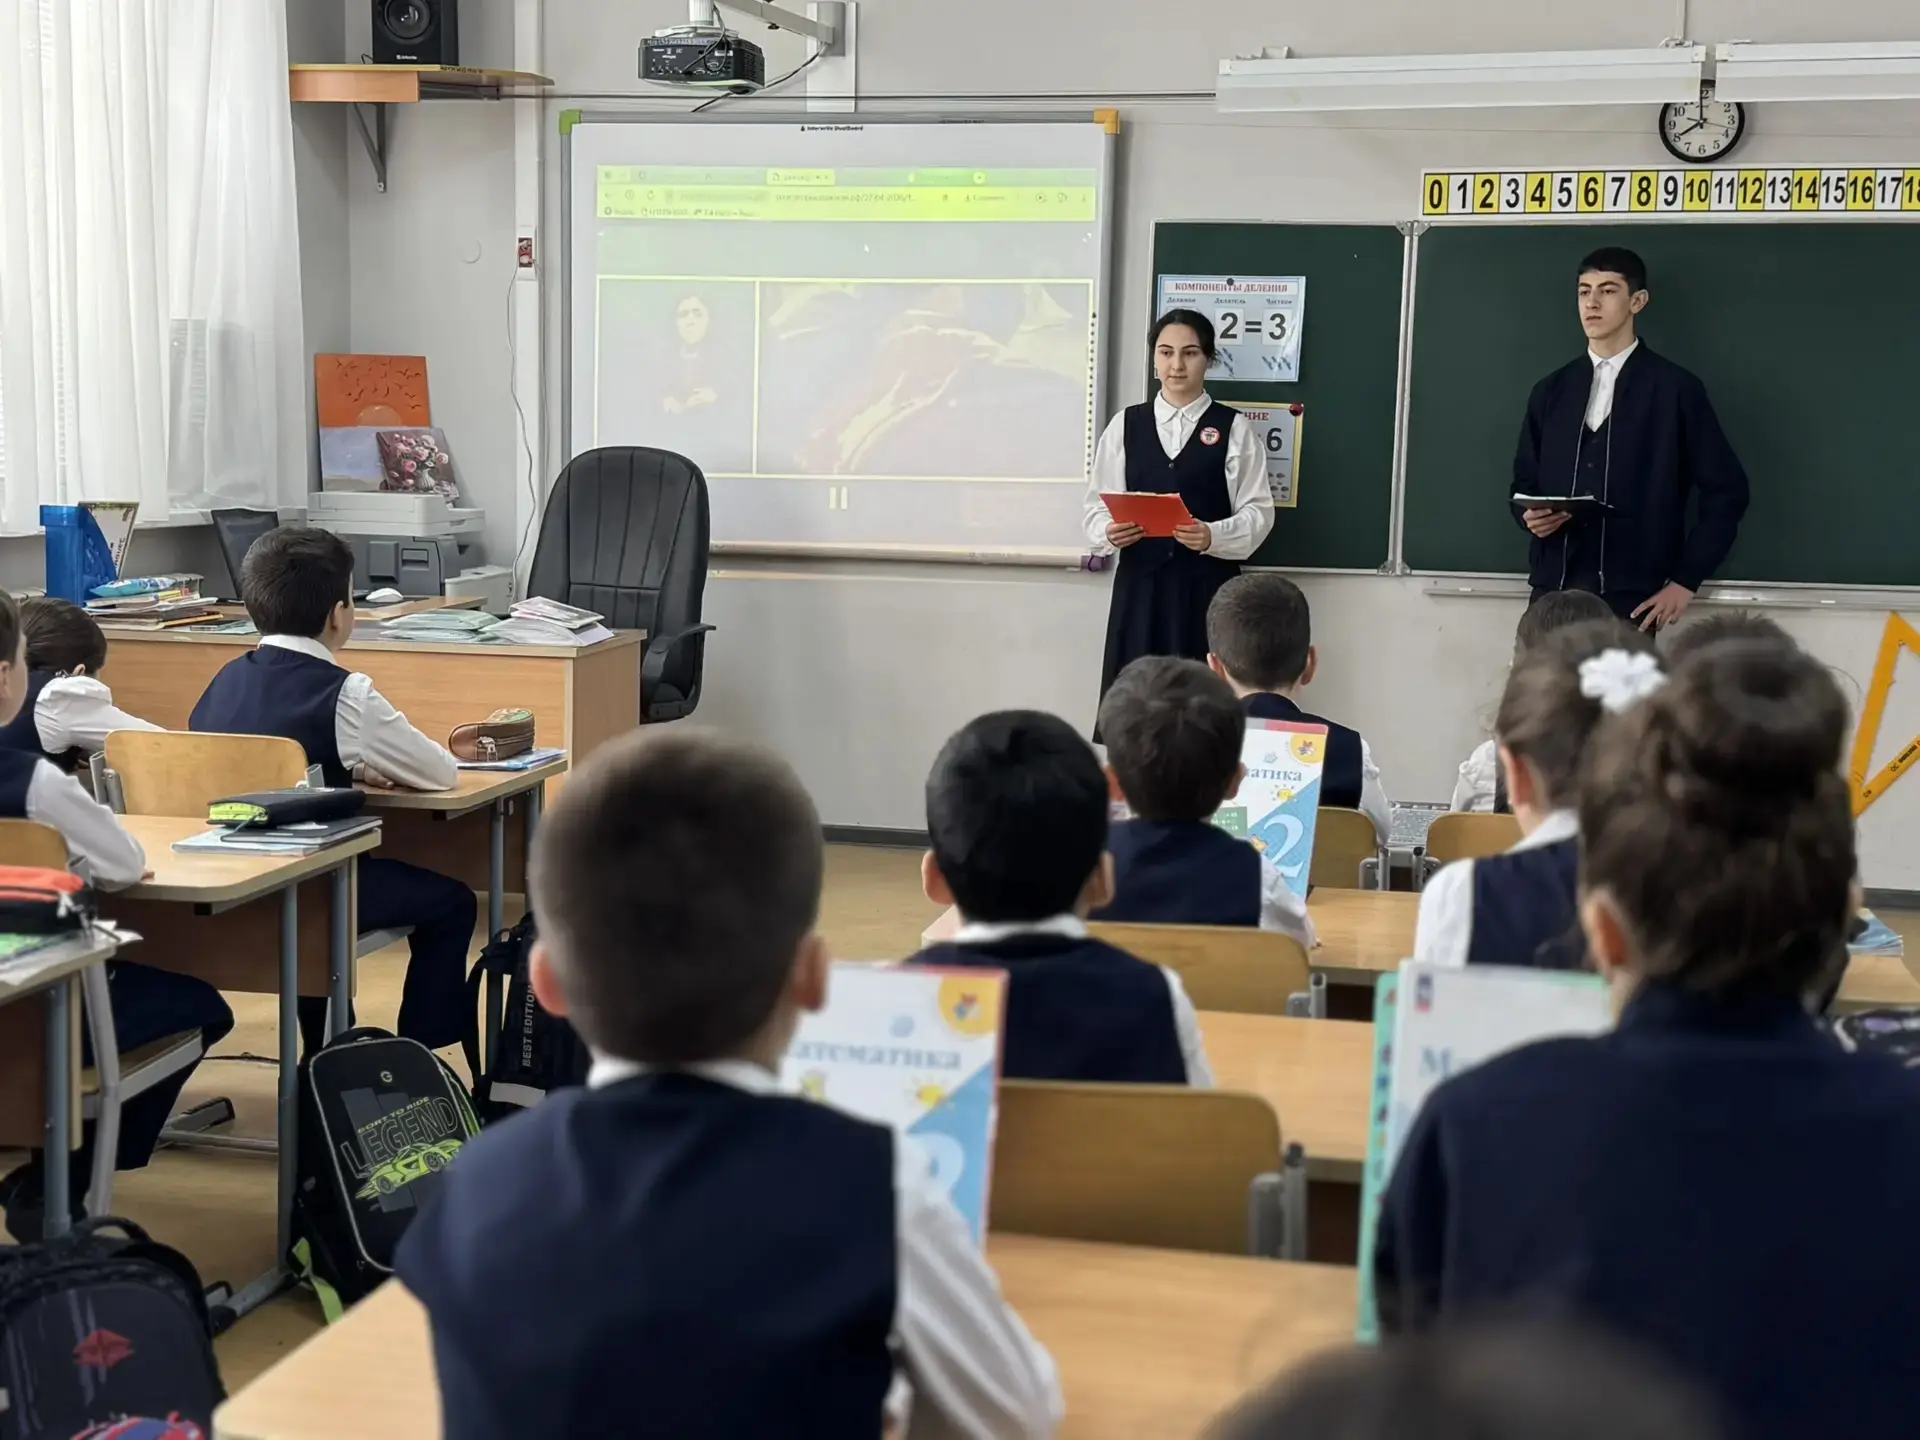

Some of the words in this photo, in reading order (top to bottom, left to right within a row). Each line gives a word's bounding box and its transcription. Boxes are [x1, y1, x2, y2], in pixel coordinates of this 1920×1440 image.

[1673, 105, 1686, 117] 10
[1723, 102, 1731, 113] 2
[1668, 119, 1677, 131] 9
[1727, 114, 1736, 125] 3
[1673, 132, 1682, 142] 8
[1684, 141, 1692, 152] 7
[1698, 144, 1707, 155] 6
[1712, 139, 1720, 150] 5
[1429, 179, 1443, 209] 0
[1457, 178, 1468, 209] 1
[1479, 178, 1495, 209] 2
[1505, 177, 1520, 208] 3
[1531, 177, 1546, 208] 4
[1557, 177, 1573, 207] 5
[1583, 176, 1599, 207] 6
[1610, 176, 1626, 206] 7
[1636, 176, 1652, 206] 8
[1663, 175, 1679, 206] 9
[1685, 177, 1709, 203] 10
[1714, 176, 1736, 204] 11
[1739, 176, 1763, 204] 12
[1767, 176, 1791, 204] 13
[1794, 176, 1818, 204] 14
[1821, 176, 1846, 204] 15
[1849, 176, 1873, 204] 16
[1877, 176, 1902, 204] 17
[1175, 282, 1241, 292] КОМПОНЕНТЫ
[1243, 283, 1288, 293] ДЕЛЕНИЯ
[1266, 427, 1283, 452] 6
[1263, 814, 1304, 878] 2
[522, 1036, 533, 1068] BEST
[799, 1041, 961, 1070] атематика
[390, 1108, 405, 1117] TO
[406, 1096, 429, 1110] RIDE
[340, 1096, 458, 1179] LEGEND
